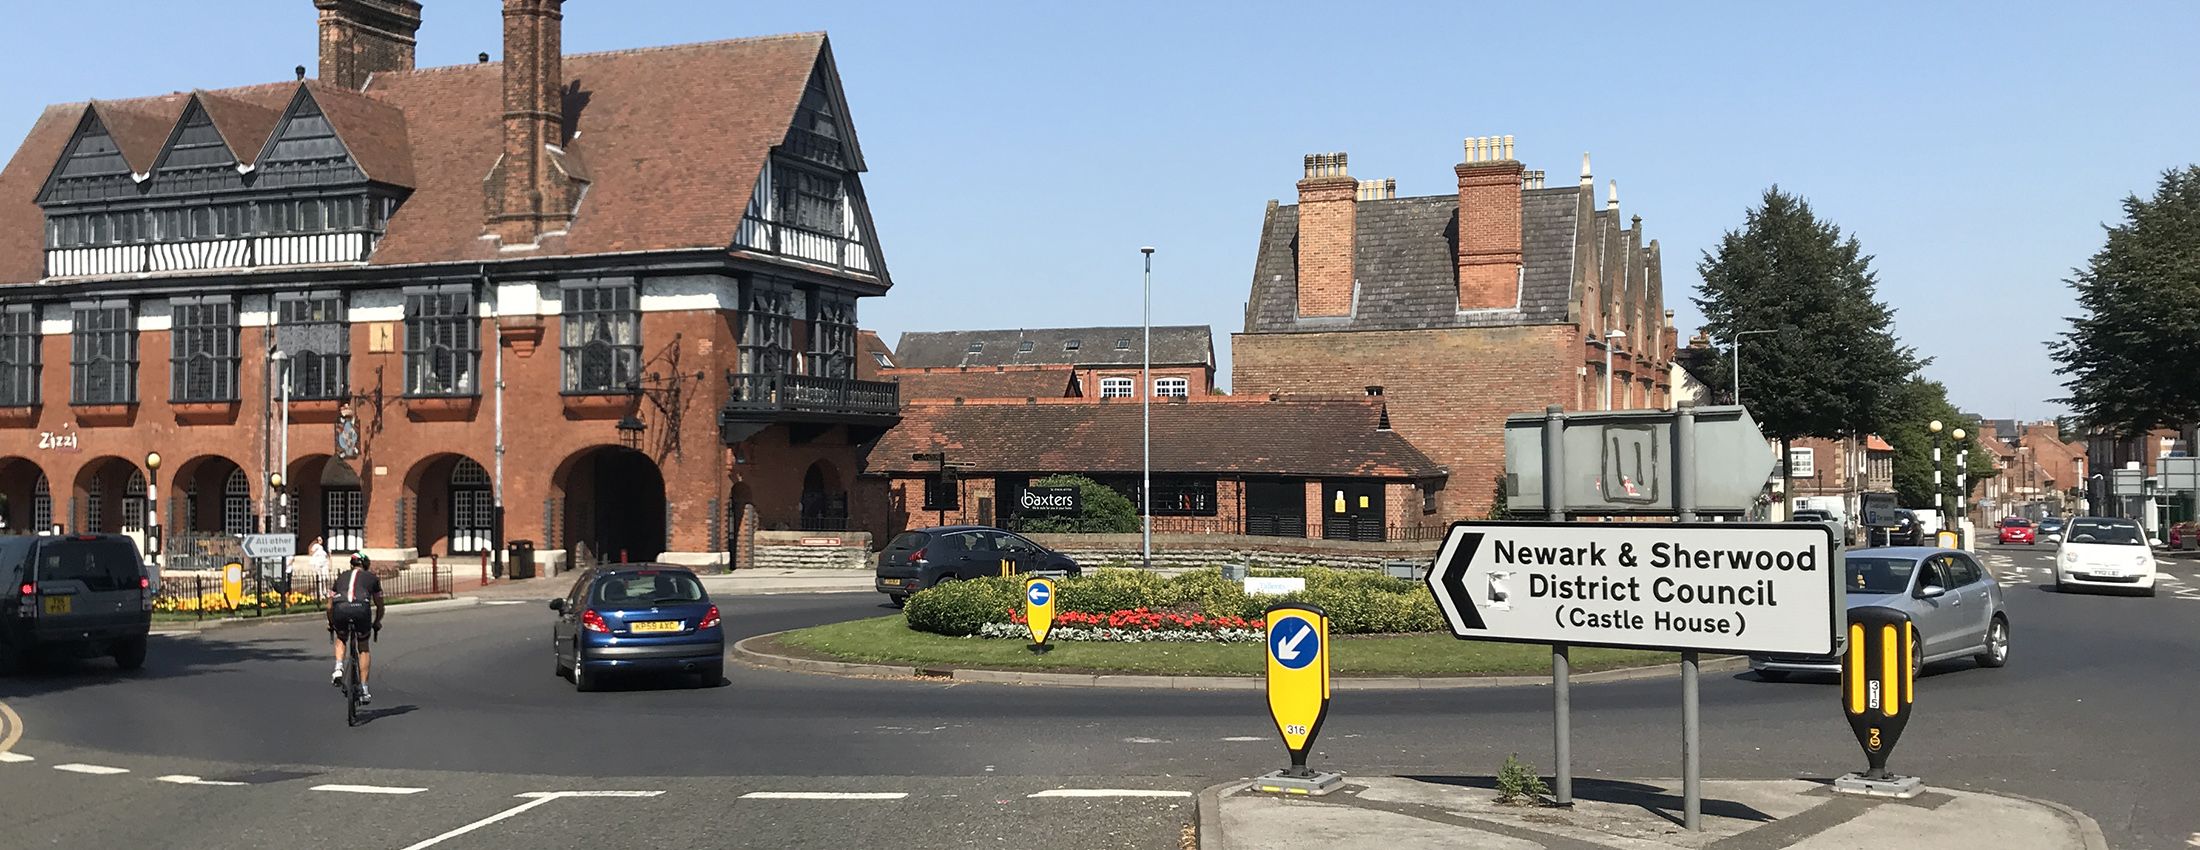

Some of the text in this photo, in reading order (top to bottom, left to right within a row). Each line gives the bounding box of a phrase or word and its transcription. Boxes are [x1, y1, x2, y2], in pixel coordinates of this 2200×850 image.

[38, 431, 78, 450] Zizzi
[1020, 488, 1073, 508] baxters
[1493, 540, 1817, 572] Newark & Sherwood
[1529, 573, 1778, 607] District Council
[1555, 604, 1747, 638] (Castle House)
[1871, 681, 1879, 708] 315
[1287, 724, 1305, 735] 316
